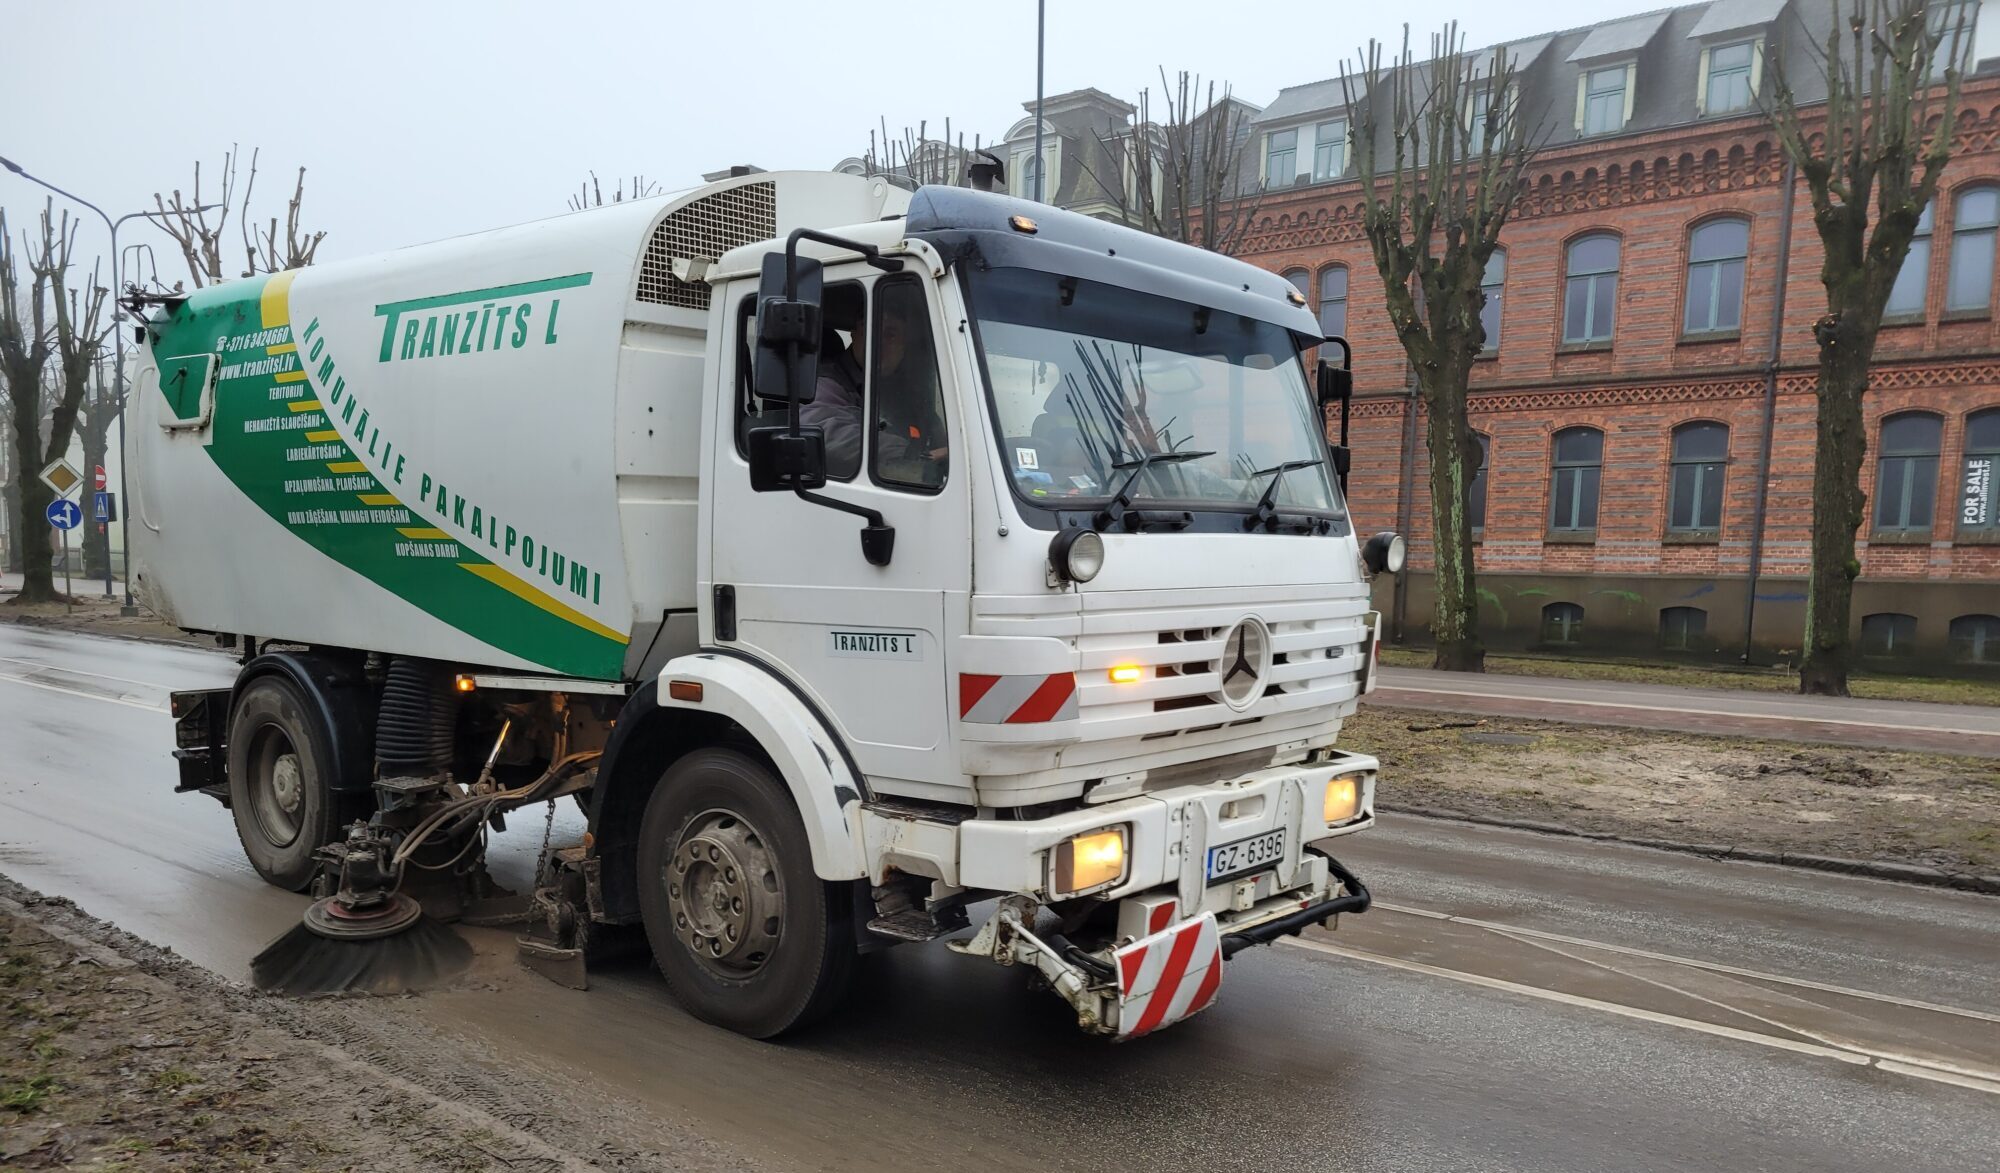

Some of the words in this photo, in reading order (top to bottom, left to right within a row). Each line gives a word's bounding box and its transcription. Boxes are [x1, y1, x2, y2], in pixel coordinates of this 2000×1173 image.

[545, 299, 560, 345] L
[226, 336, 244, 352] +371
[243, 333, 251, 350] 6
[250, 327, 289, 348] 3424660
[219, 354, 295, 380] www.tranzitsl.lv
[269, 385, 304, 401] TERITORIJU
[303, 317, 405, 485] KOMUNĀLIE
[421, 473, 601, 605] PAKALPOJUMI
[1967, 460, 1983, 493] SALE
[287, 511, 306, 525] KOKU
[339, 510, 370, 524] VAINAGU
[369, 507, 411, 524] VEIDOŠANA
[1963, 498, 1979, 524] FOR
[395, 541, 434, 558] KOPŠANAS
[433, 544, 459, 559] DARBI
[906, 638, 912, 652] L
[1216, 834, 1282, 872] GZ-6396
